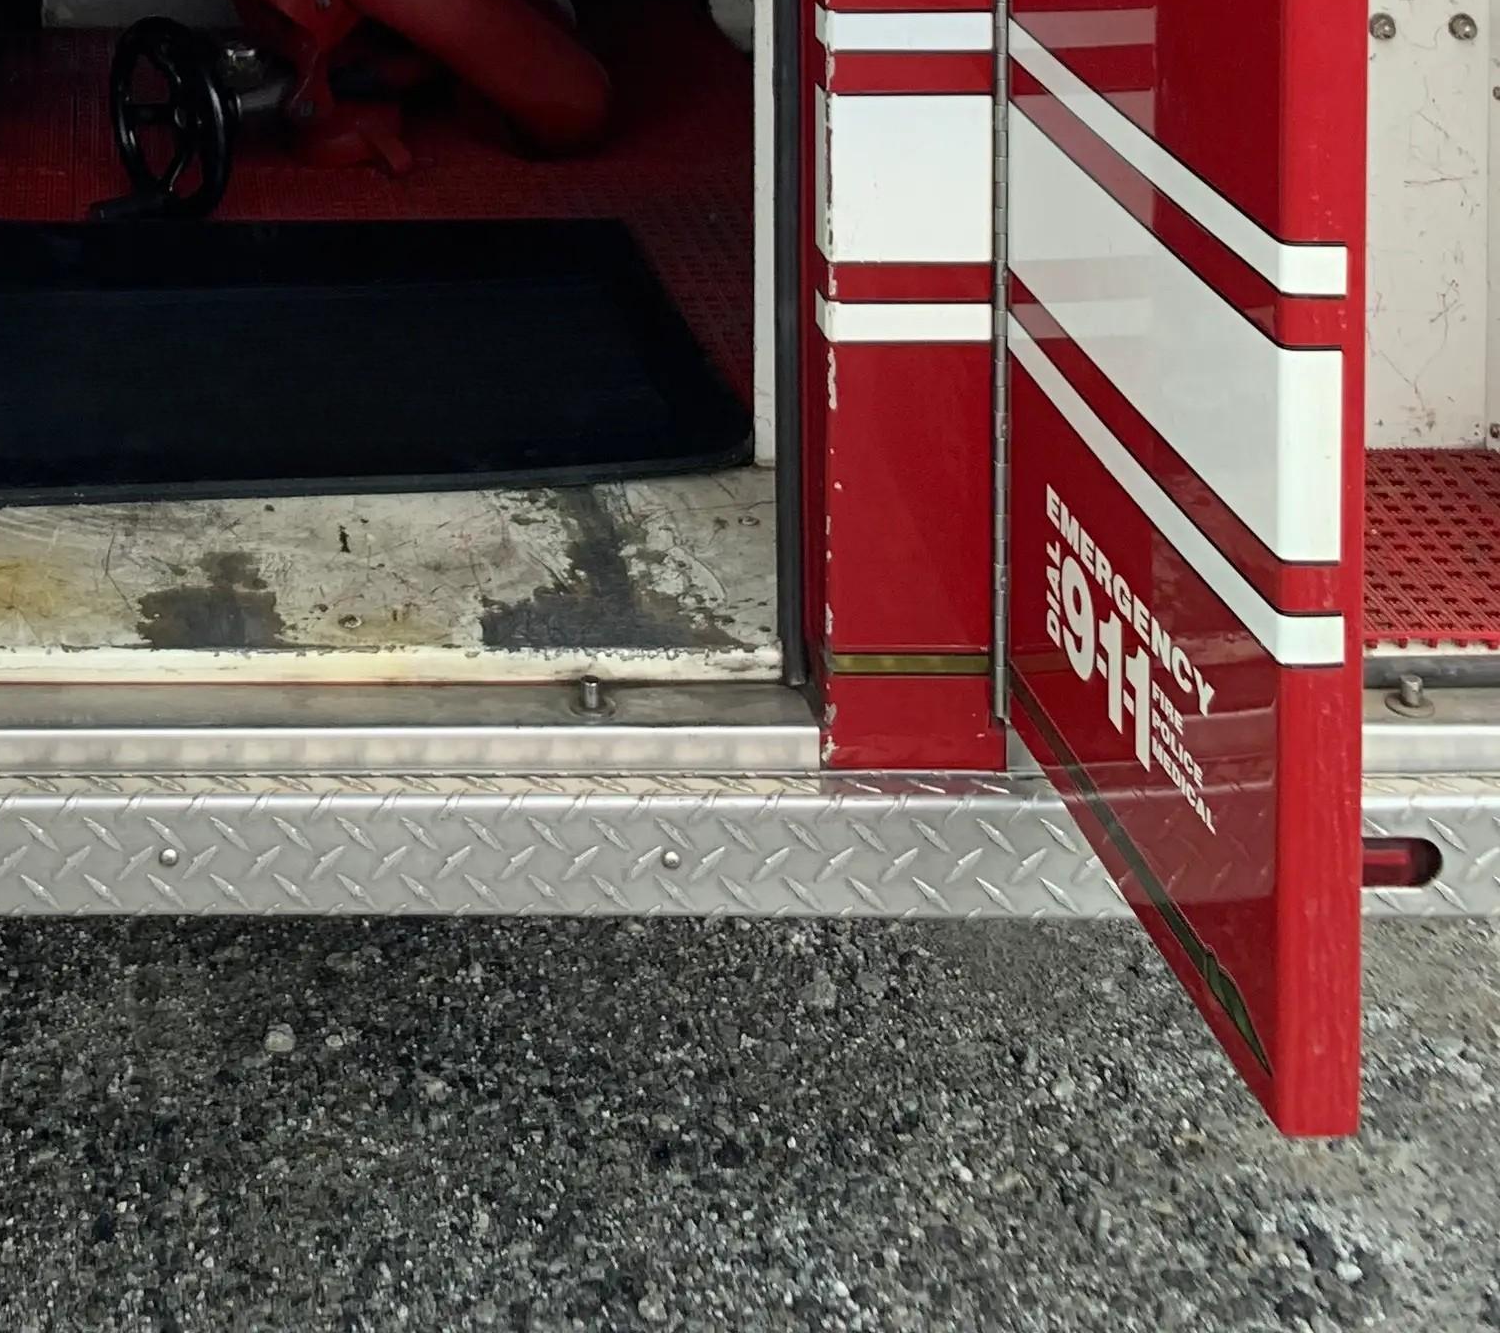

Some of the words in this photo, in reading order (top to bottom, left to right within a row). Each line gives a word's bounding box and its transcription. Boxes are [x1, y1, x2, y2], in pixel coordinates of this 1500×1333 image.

[1046, 541, 1061, 649] DIAL
[1046, 484, 1215, 717] EMERGENCY
[1151, 680, 1184, 736] FIRE
[1151, 708, 1203, 791] POLICE
[1151, 737, 1216, 836] MEDICAL
